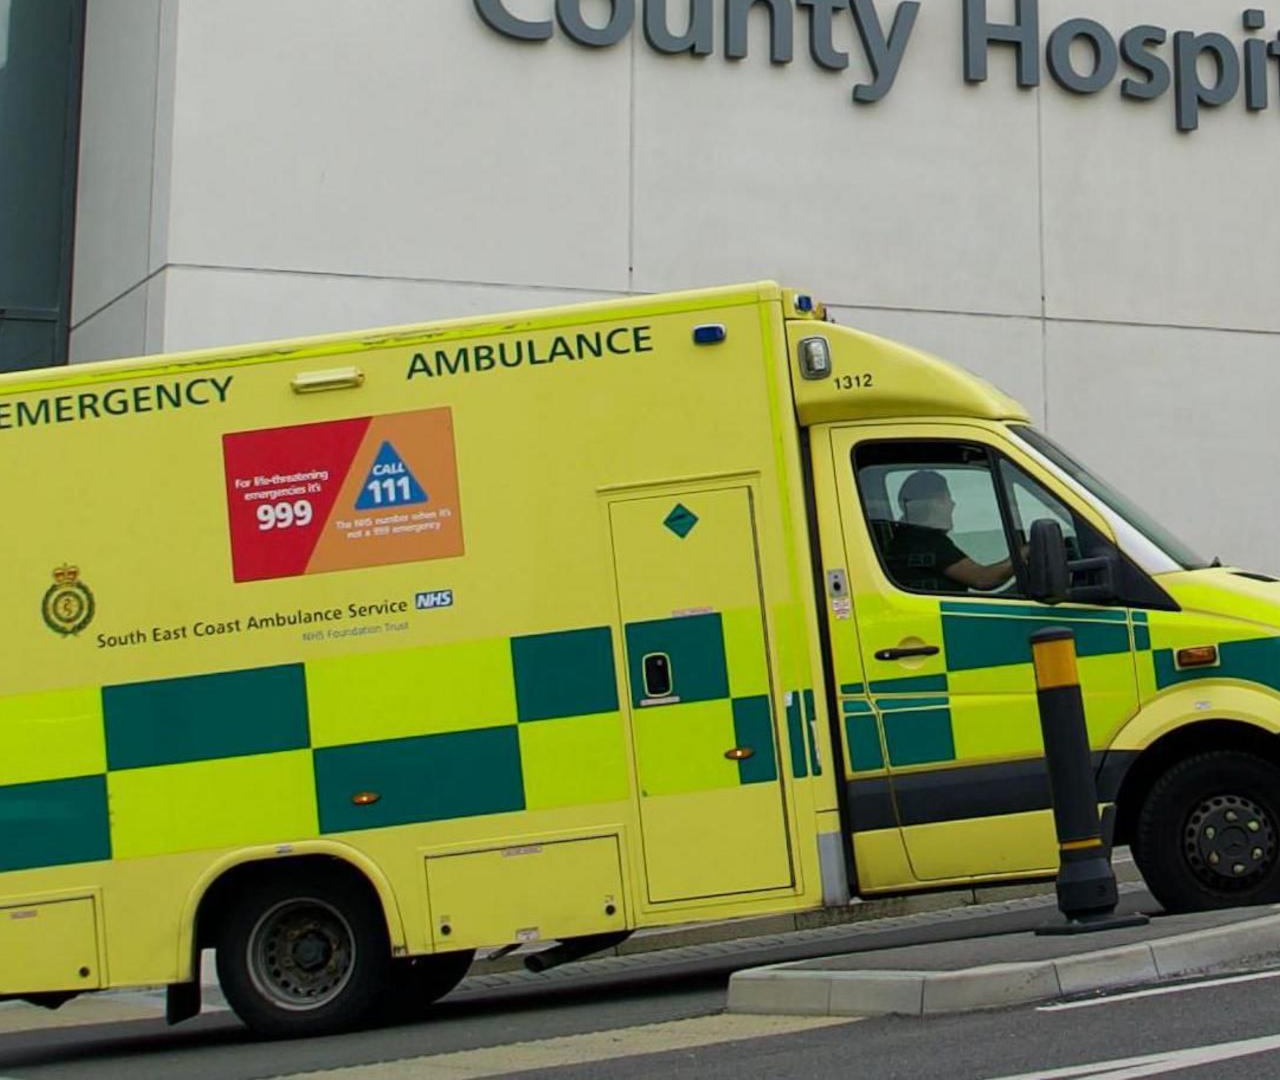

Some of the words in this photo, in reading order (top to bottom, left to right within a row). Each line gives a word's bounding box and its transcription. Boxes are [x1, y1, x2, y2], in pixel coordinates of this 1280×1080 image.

[406, 324, 654, 380] AMBULANCE
[834, 373, 874, 390] 1312
[372, 462, 406, 476] CALL
[235, 478, 252, 490] For
[253, 470, 329, 487] life-threatening
[244, 486, 307, 501] emergencies
[367, 475, 412, 504] 111
[256, 499, 313, 531] 999
[335, 520, 352, 530] The
[375, 514, 409, 525] number
[392, 521, 441, 534] emergency
[417, 592, 452, 608] NHS
[96, 624, 147, 649] South
[152, 624, 188, 643] East
[193, 618, 241, 638] Coast
[246, 607, 343, 631] Ambulance
[347, 598, 409, 620] Service
[302, 630, 325, 641] NHS
[328, 624, 382, 639] Foundation
[384, 621, 409, 633] Trust
